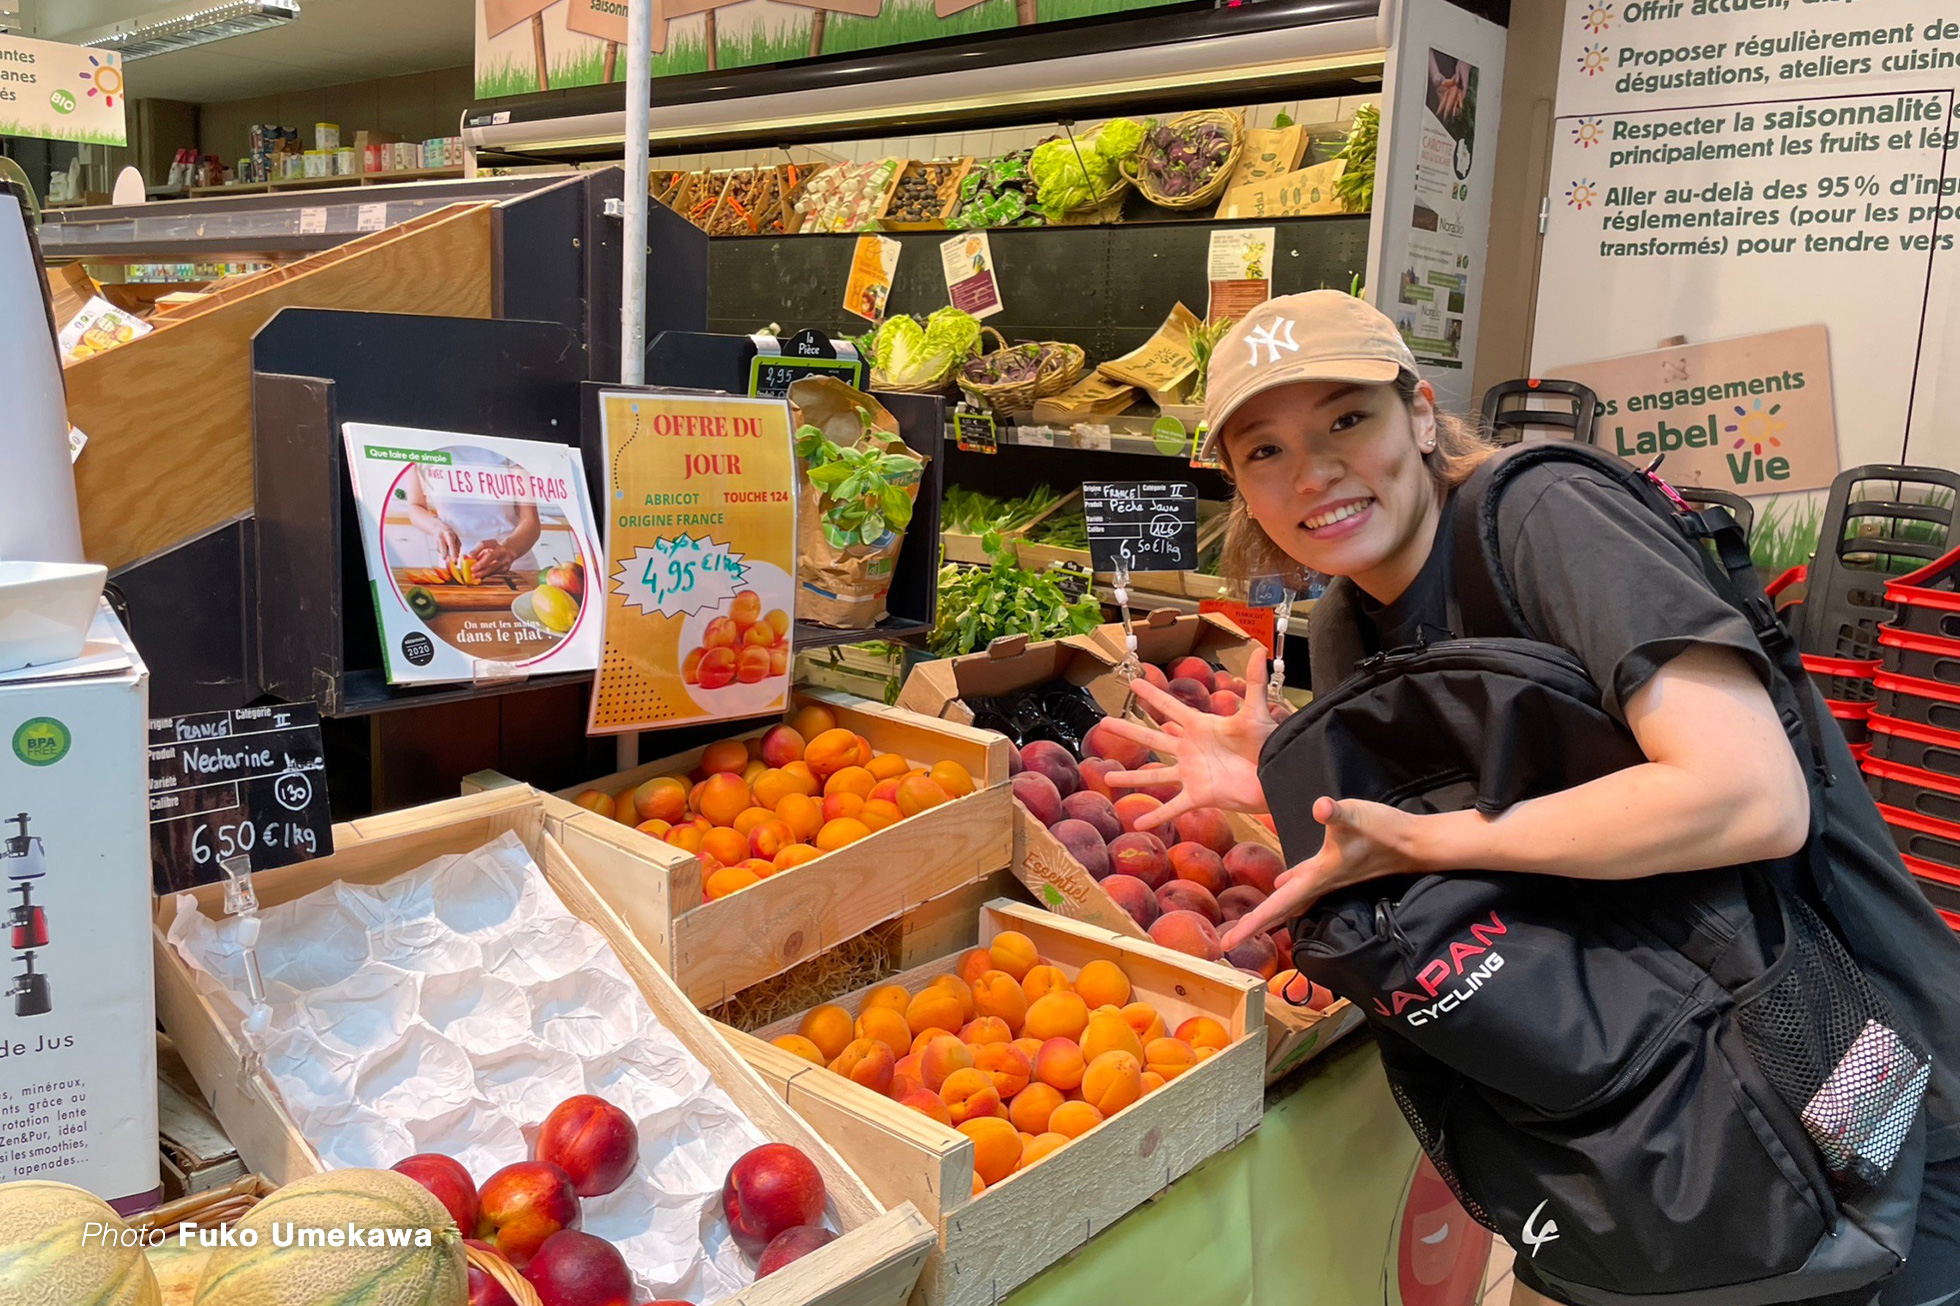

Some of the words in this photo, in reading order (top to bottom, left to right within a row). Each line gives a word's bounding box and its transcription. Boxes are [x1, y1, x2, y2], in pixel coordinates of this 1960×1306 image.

[1623, 0, 1683, 23] Offrir
[1618, 42, 1726, 68] Proposer
[1734, 23, 1914, 57] régulièrement
[1923, 18, 1960, 41] de
[0, 50, 35, 63] ntes
[1, 70, 36, 83] anes
[1615, 63, 1770, 93] dégustations,
[1779, 55, 1871, 80] ateliers
[51, 92, 75, 111] BIO
[1612, 116, 1726, 141] Respecter
[1733, 112, 1755, 132] la
[1763, 96, 1943, 131] saisonnalité
[1609, 138, 1774, 168] principalement
[1780, 135, 1813, 154] les
[1820, 131, 1881, 153] fruits
[1887, 131, 1913, 150] et
[1604, 187, 1657, 206] Aller
[1664, 180, 1754, 203] au-delà
[1762, 179, 1808, 200] des
[1889, 172, 1960, 197] d'ing
[1602, 206, 1780, 232] réglementaires
[1789, 204, 1856, 227] (pour
[1864, 203, 1899, 222] les
[1600, 235, 1729, 257] transformés)
[1736, 237, 1797, 257] pour
[1804, 230, 1890, 252] tendre
[1899, 234, 1954, 251] vers
[798, 342, 820, 355] Pièce
[806, 331, 814, 344] la
[1243, 315, 1300, 368] NY
[1627, 370, 1806, 413] engagements
[653, 414, 729, 437] OFFRE
[732, 416, 763, 438] DU
[1615, 414, 1719, 457] Label
[369, 448, 388, 457] Que
[408, 452, 420, 460] de
[421, 453, 447, 463] simple
[684, 454, 742, 480] JOUR
[1726, 451, 1791, 485] Vie
[428, 468, 444, 479] AVEC
[448, 470, 474, 493] LES
[479, 472, 524, 499] FRUITS
[530, 476, 568, 502] FRAIS
[1103, 484, 1137, 499] FRANCE
[1170, 484, 1188, 498] II
[645, 493, 699, 505] ABRICOT
[724, 492, 767, 503] TOUCHE
[770, 491, 788, 502] 124
[619, 515, 673, 527] ORIGINE
[677, 513, 724, 526] FRANCE
[641, 556, 697, 605] 4,95
[456, 630, 493, 643] dans
[497, 629, 511, 641] le
[514, 628, 543, 644] plat
[463, 620, 479, 630] On
[481, 621, 498, 629] met
[499, 621, 512, 629] les
[407, 644, 430, 657] 2020
[149, 718, 173, 731] rigine
[175, 718, 228, 742] FRANCE
[27, 737, 56, 748] BPA
[27, 746, 58, 756] FREE
[183, 745, 275, 774] Nectarine
[150, 796, 180, 812] Calibre
[191, 820, 256, 864] 6,50
[1022, 851, 1090, 904] Essentiel
[1373, 910, 1508, 1017] JAPAN
[1406, 951, 1505, 1027] CYCLING
[0, 1039, 26, 1059] de
[34, 1034, 75, 1052] Jus
[21, 1078, 85, 1097] minéraux,
[28, 1096, 63, 1114] grâce
[71, 1093, 86, 1103] au
[2, 1115, 50, 1131] rotation
[57, 1108, 87, 1121] lente
[58, 1121, 88, 1136] idéal
[11, 1149, 27, 1161] les
[29, 1139, 89, 1158] smoothies,
[14, 1157, 89, 1177] tapenades...
